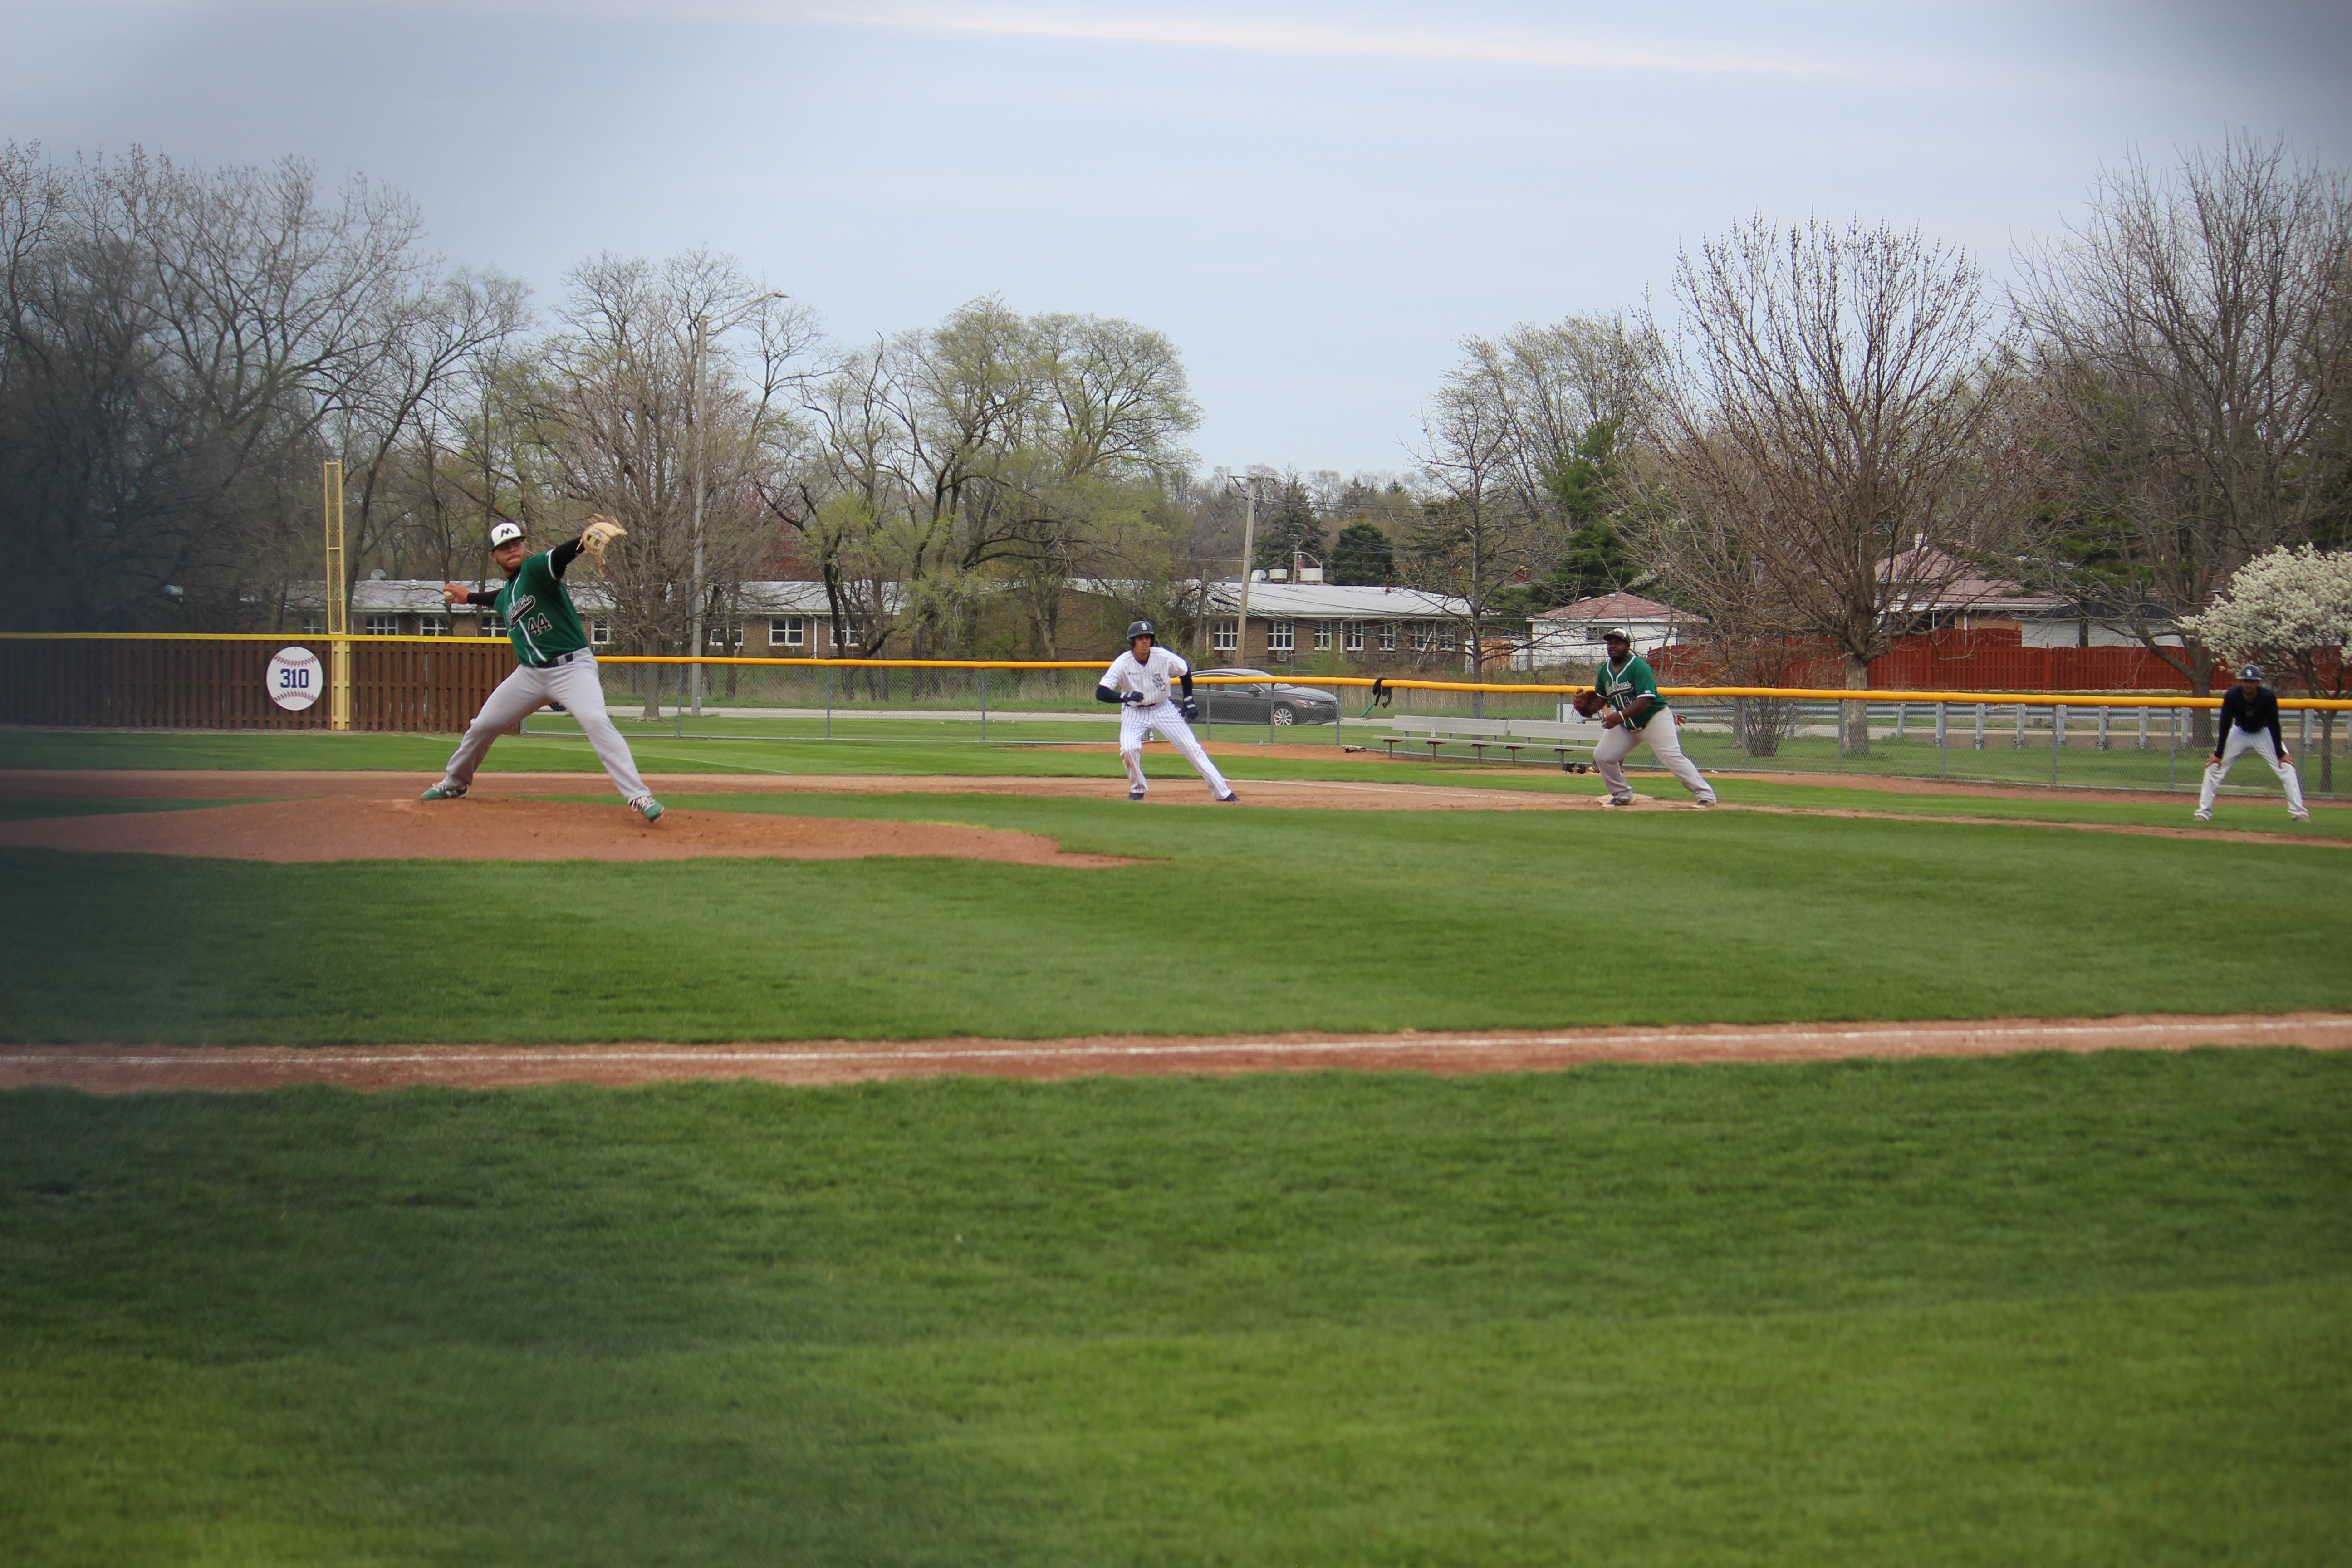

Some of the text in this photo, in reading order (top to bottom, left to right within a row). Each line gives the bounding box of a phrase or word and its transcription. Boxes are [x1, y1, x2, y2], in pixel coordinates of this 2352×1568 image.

[501, 528, 514, 538] M
[528, 612, 552, 636] 44
[280, 669, 309, 688] 310
